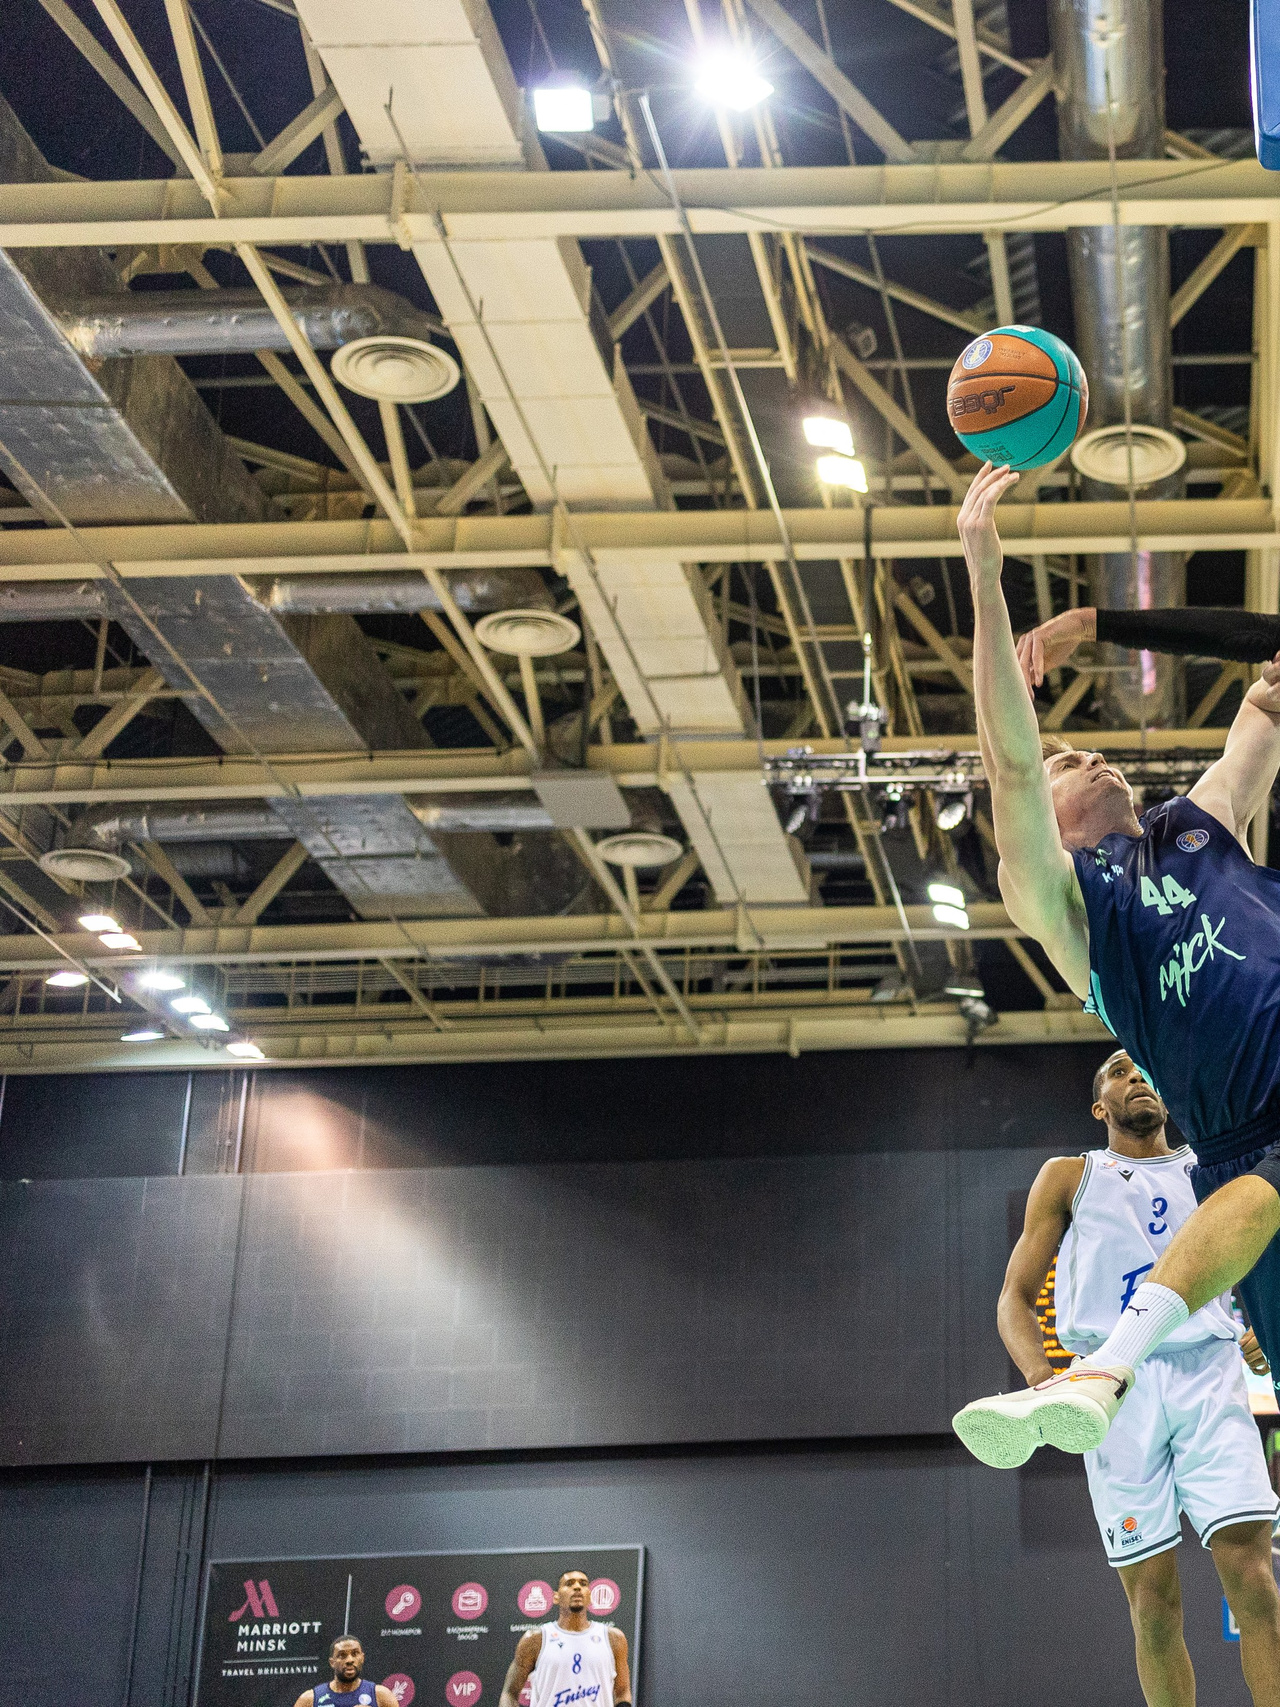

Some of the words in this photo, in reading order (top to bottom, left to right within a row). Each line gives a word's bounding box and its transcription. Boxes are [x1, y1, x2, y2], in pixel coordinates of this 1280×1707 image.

[1140, 873, 1197, 916] 44
[1148, 1196, 1169, 1236] 3
[1121, 1533, 1144, 1546] ENISEY
[237, 1621, 323, 1637] MARRIOTT
[236, 1638, 288, 1653] MINSK
[221, 1667, 255, 1677] TRAVEL
[571, 1653, 582, 1675] 8
[452, 1682, 477, 1697] VIP
[553, 1685, 601, 1707] Enisey
